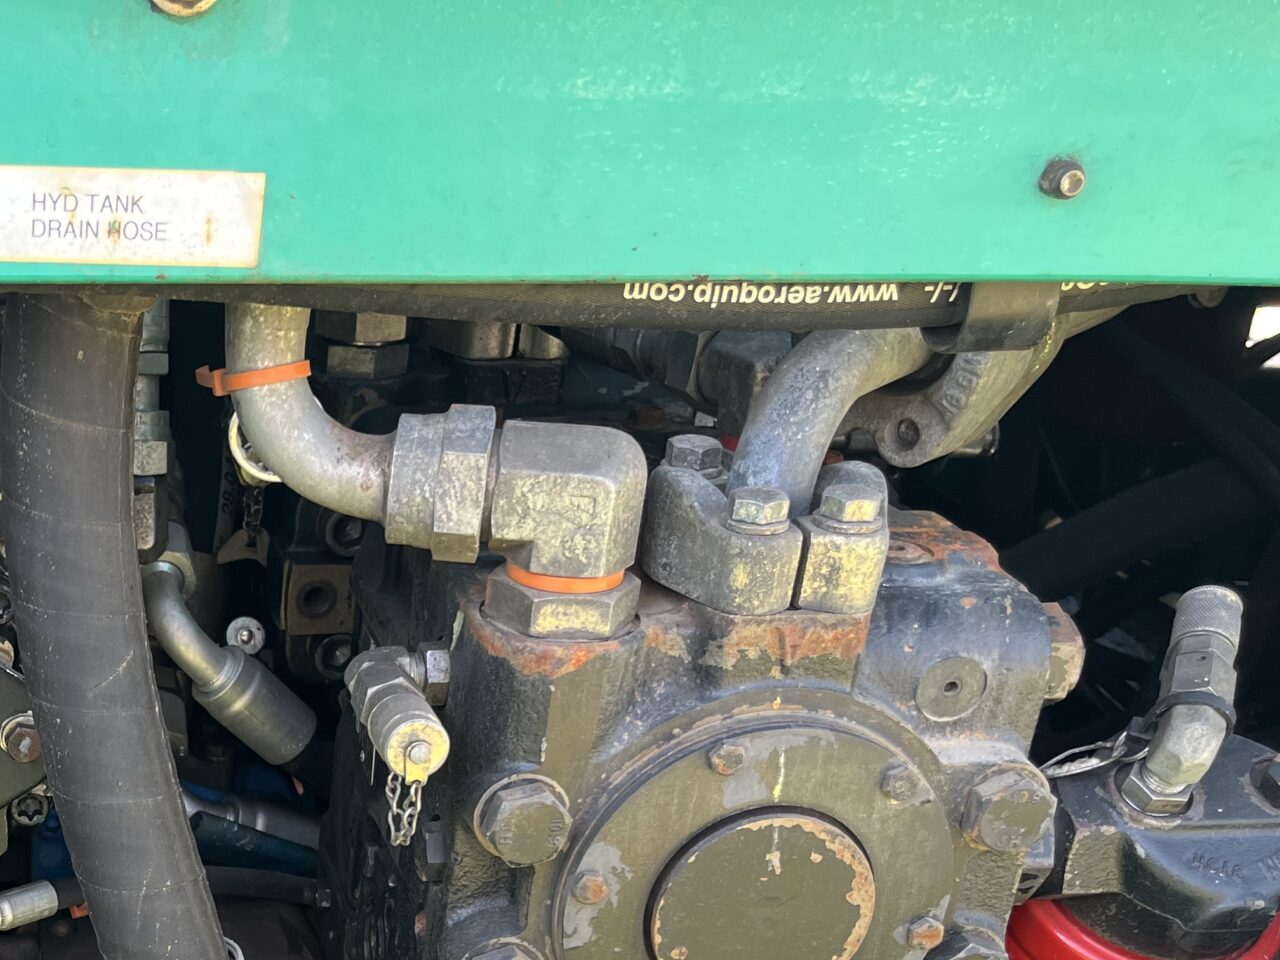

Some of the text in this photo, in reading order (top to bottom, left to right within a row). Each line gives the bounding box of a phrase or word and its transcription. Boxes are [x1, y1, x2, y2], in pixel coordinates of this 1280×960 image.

[32, 192, 144, 215] HYD TANK
[31, 219, 168, 241] DRAIN HOSE
[622, 282, 899, 308] www.aeroquip.com
